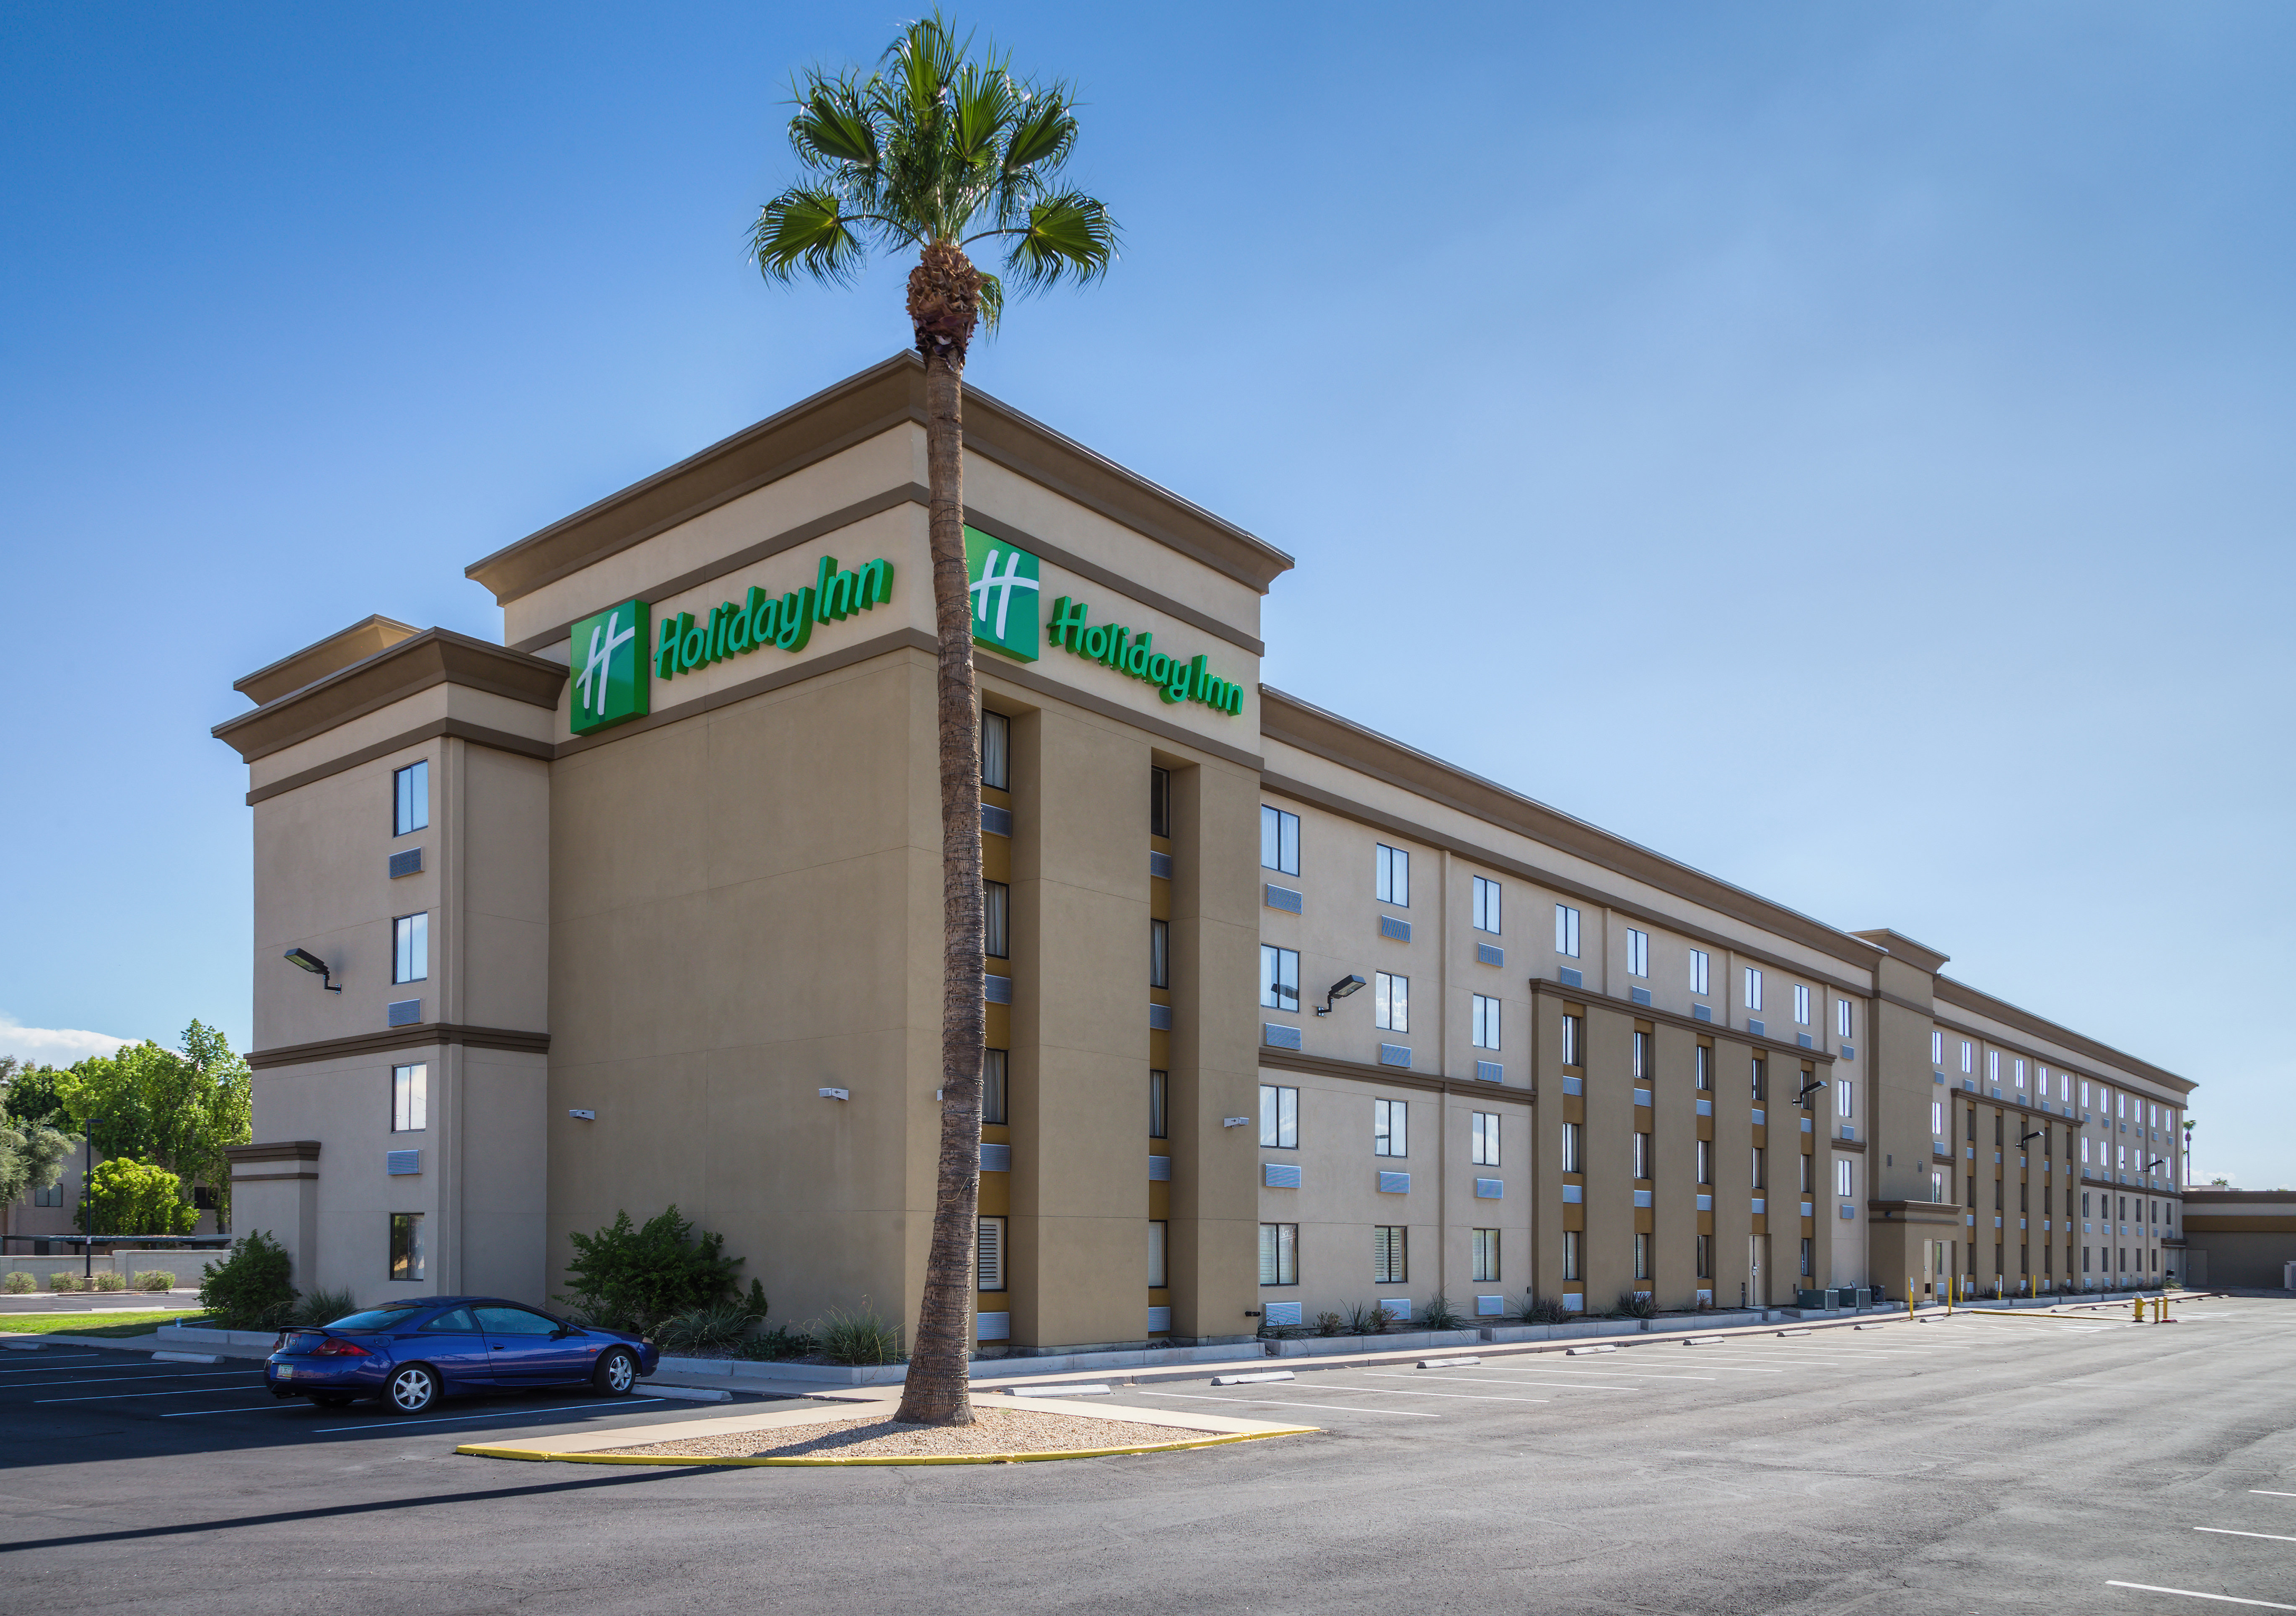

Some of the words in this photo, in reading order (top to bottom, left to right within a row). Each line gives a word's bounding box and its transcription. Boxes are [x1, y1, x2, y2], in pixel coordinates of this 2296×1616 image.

[653, 586, 815, 680] Holiday
[813, 555, 894, 625] Inn
[969, 549, 1039, 640] H
[576, 611, 635, 715] H
[1046, 596, 1192, 705] Holiday
[1187, 654, 1244, 716] Inn
